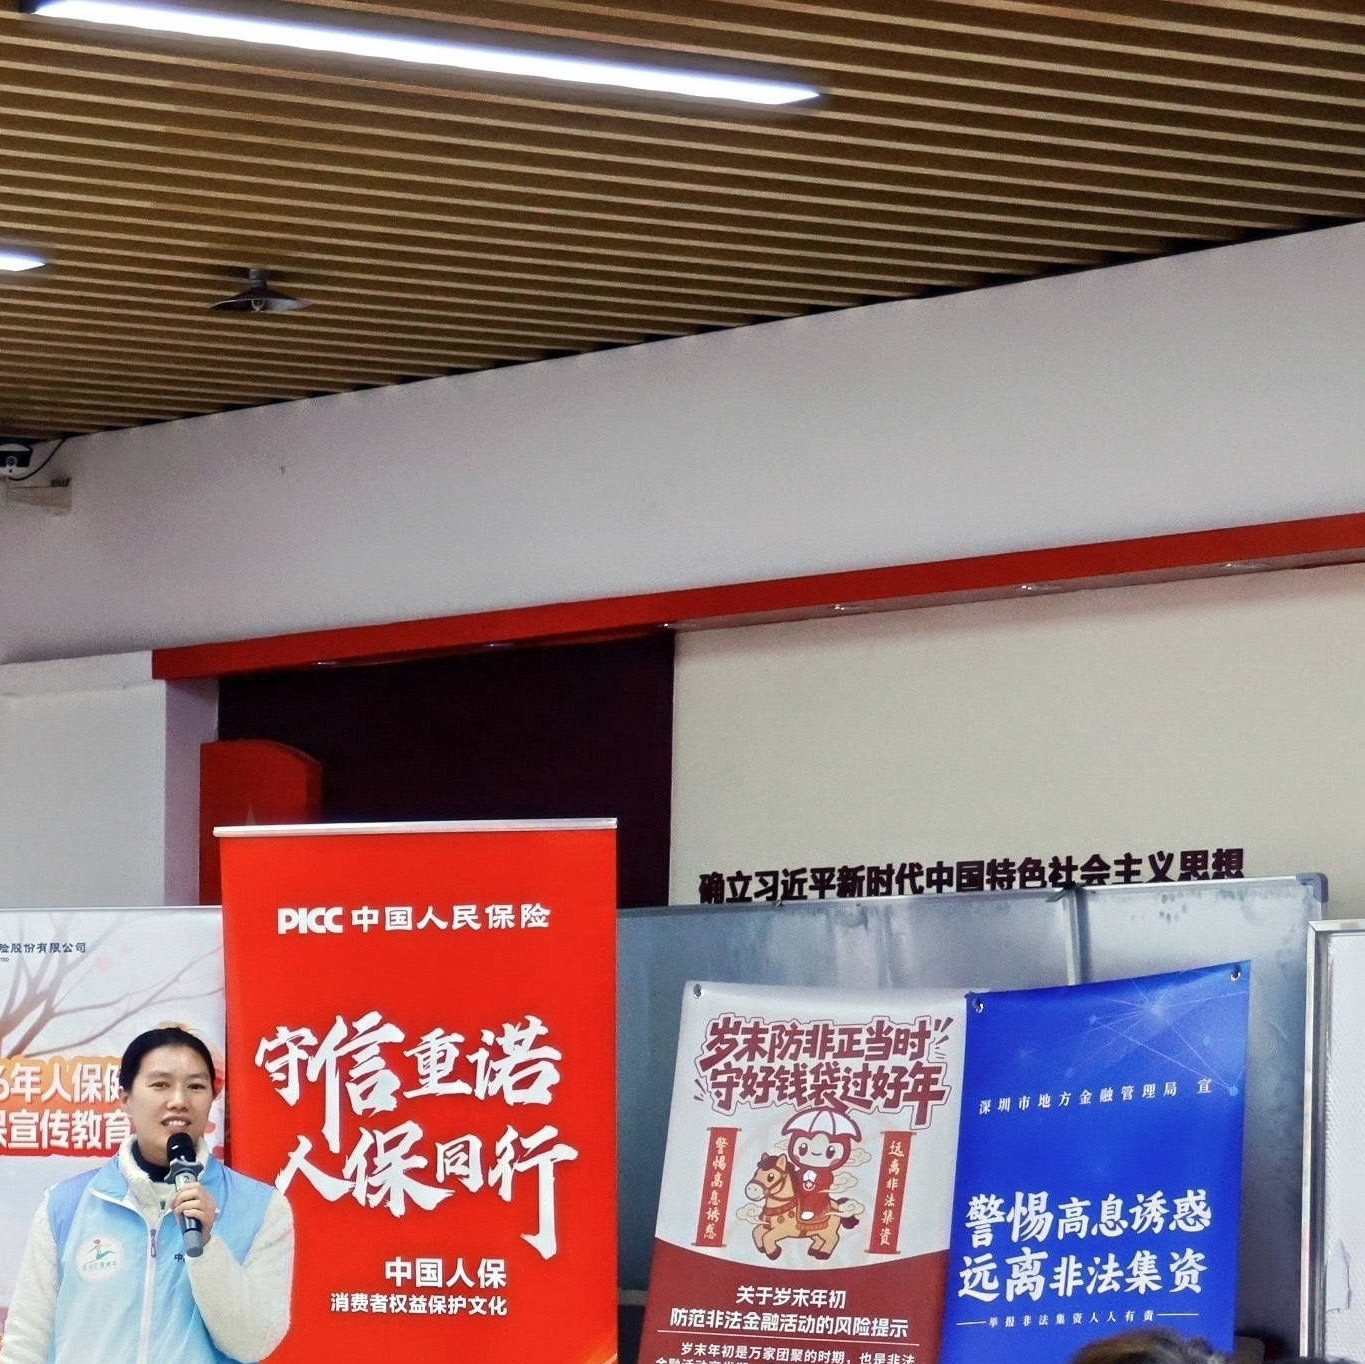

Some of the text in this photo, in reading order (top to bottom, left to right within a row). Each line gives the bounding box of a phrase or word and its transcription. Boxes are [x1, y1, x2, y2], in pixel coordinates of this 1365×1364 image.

[699, 848, 1244, 904] 确立习近平新时代中国特色社会主义思想
[278, 903, 550, 934] PICC 中国人民保险
[700, 1017, 931, 1072] 岁末防非正当时
[254, 1010, 562, 1154] 守信重诺
[710, 1061, 945, 1125] 守好钱袋过好年
[979, 1081, 1177, 1115] 深圳市地方金融管理局
[276, 1121, 578, 1260] 人保同行
[965, 1188, 1212, 1248] 警惕高息诱惑
[385, 1256, 507, 1288] 中国人保
[736, 1285, 846, 1309] 关于岁末年初
[958, 1247, 1207, 1302] 远离非法集资
[330, 1292, 508, 1316] 消费者权益保护文化
[670, 1308, 908, 1338] 防范非法金融活动的风险提示
